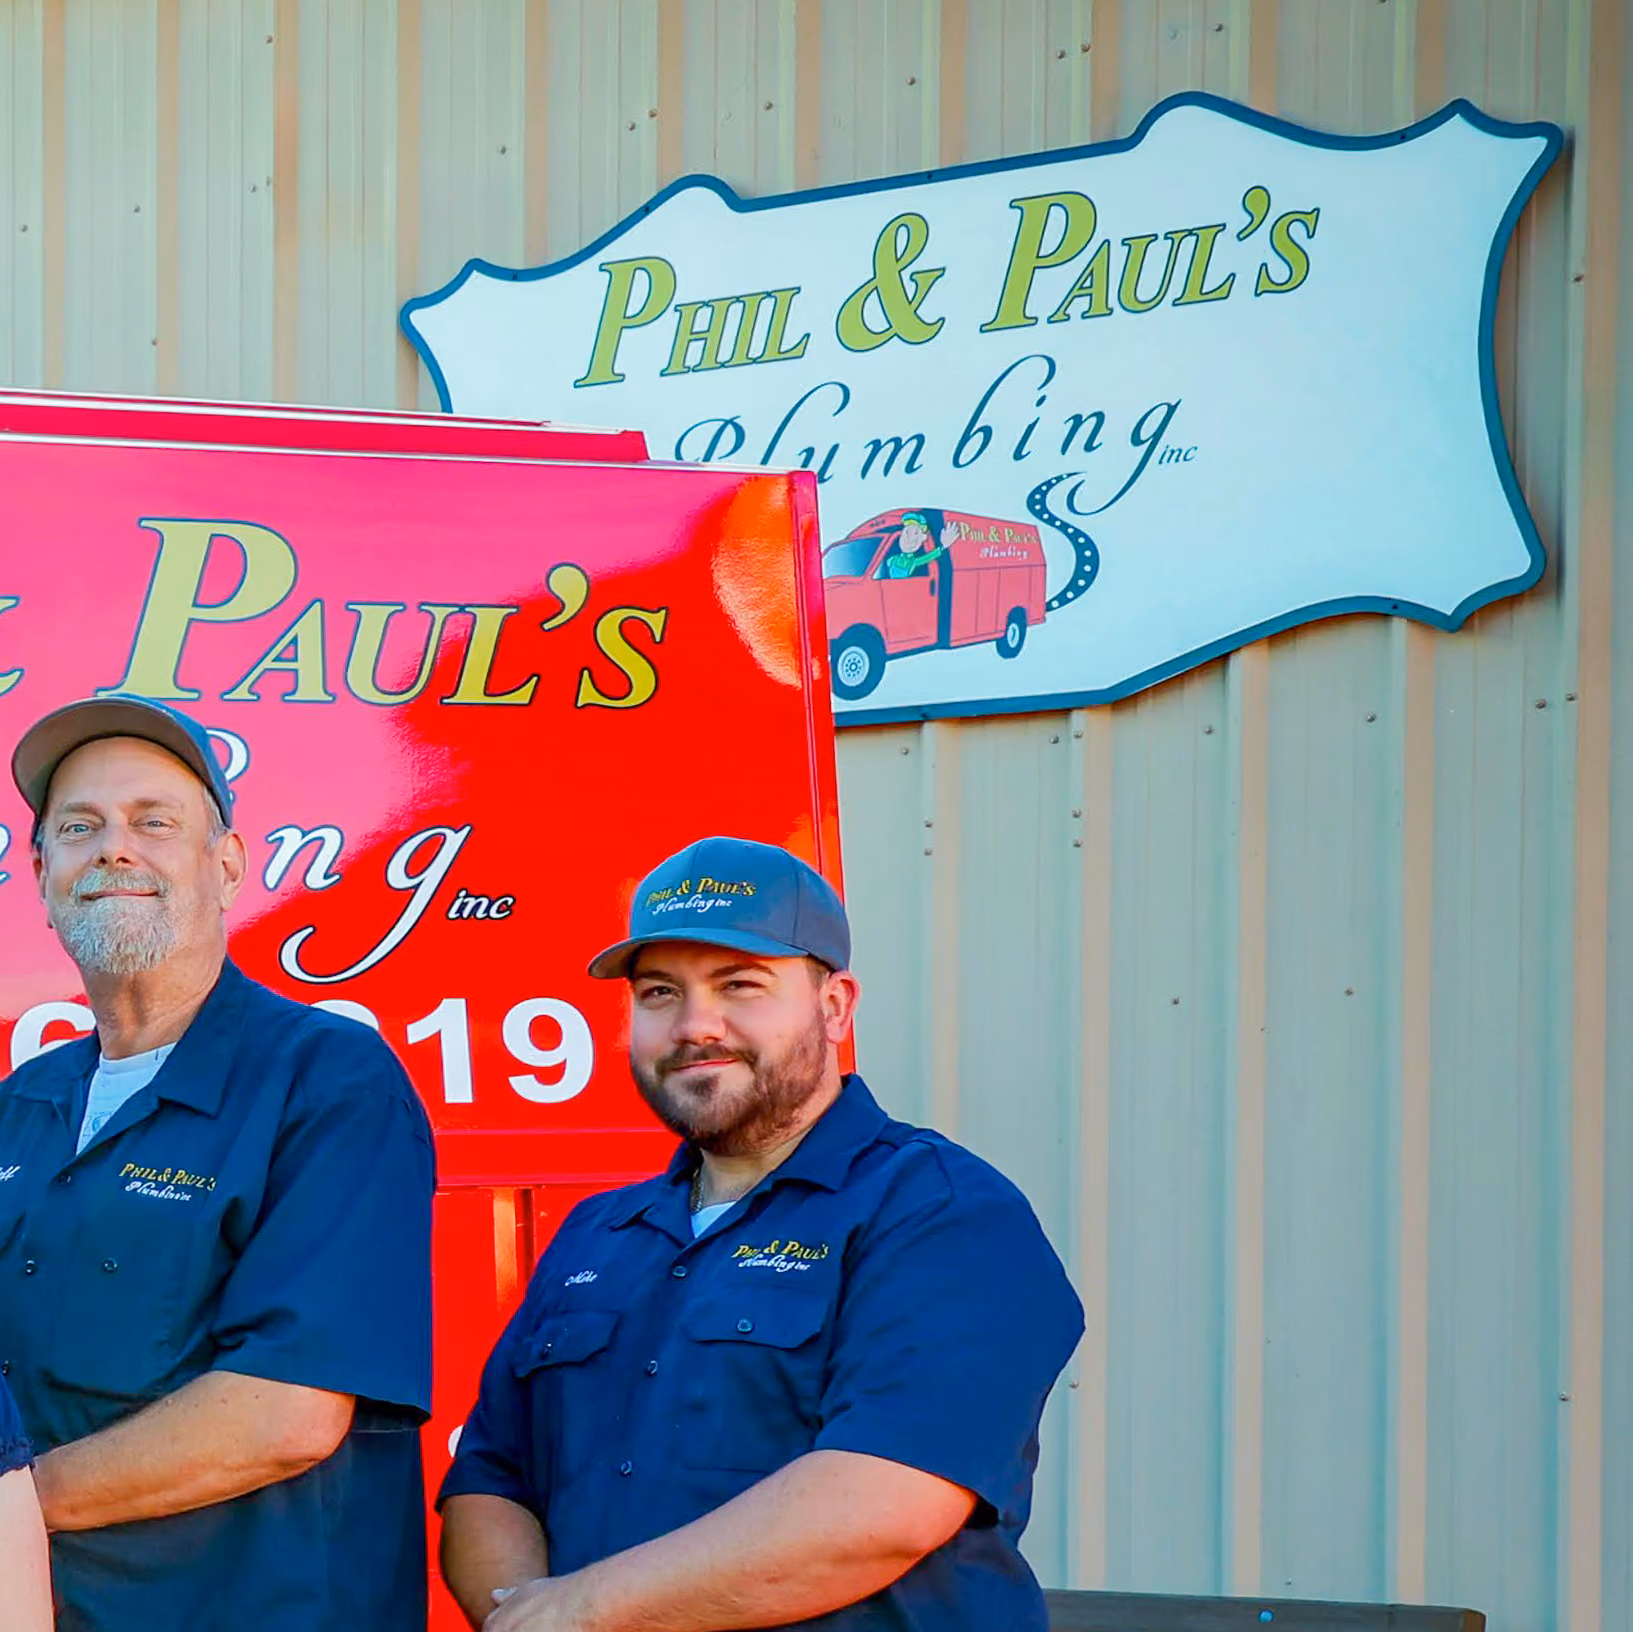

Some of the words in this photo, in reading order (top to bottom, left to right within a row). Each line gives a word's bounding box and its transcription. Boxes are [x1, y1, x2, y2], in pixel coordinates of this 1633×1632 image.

[573, 255, 810, 389] PHIL
[835, 211, 947, 353] &
[978, 184, 1321, 333] PAUL'S
[1158, 442, 1198, 465] inc
[96, 516, 669, 708] PAUL'S
[676, 879, 690, 895] &
[446, 886, 515, 921] inc
[118, 1163, 156, 1180] PHIL
[157, 1168, 172, 1182] &
